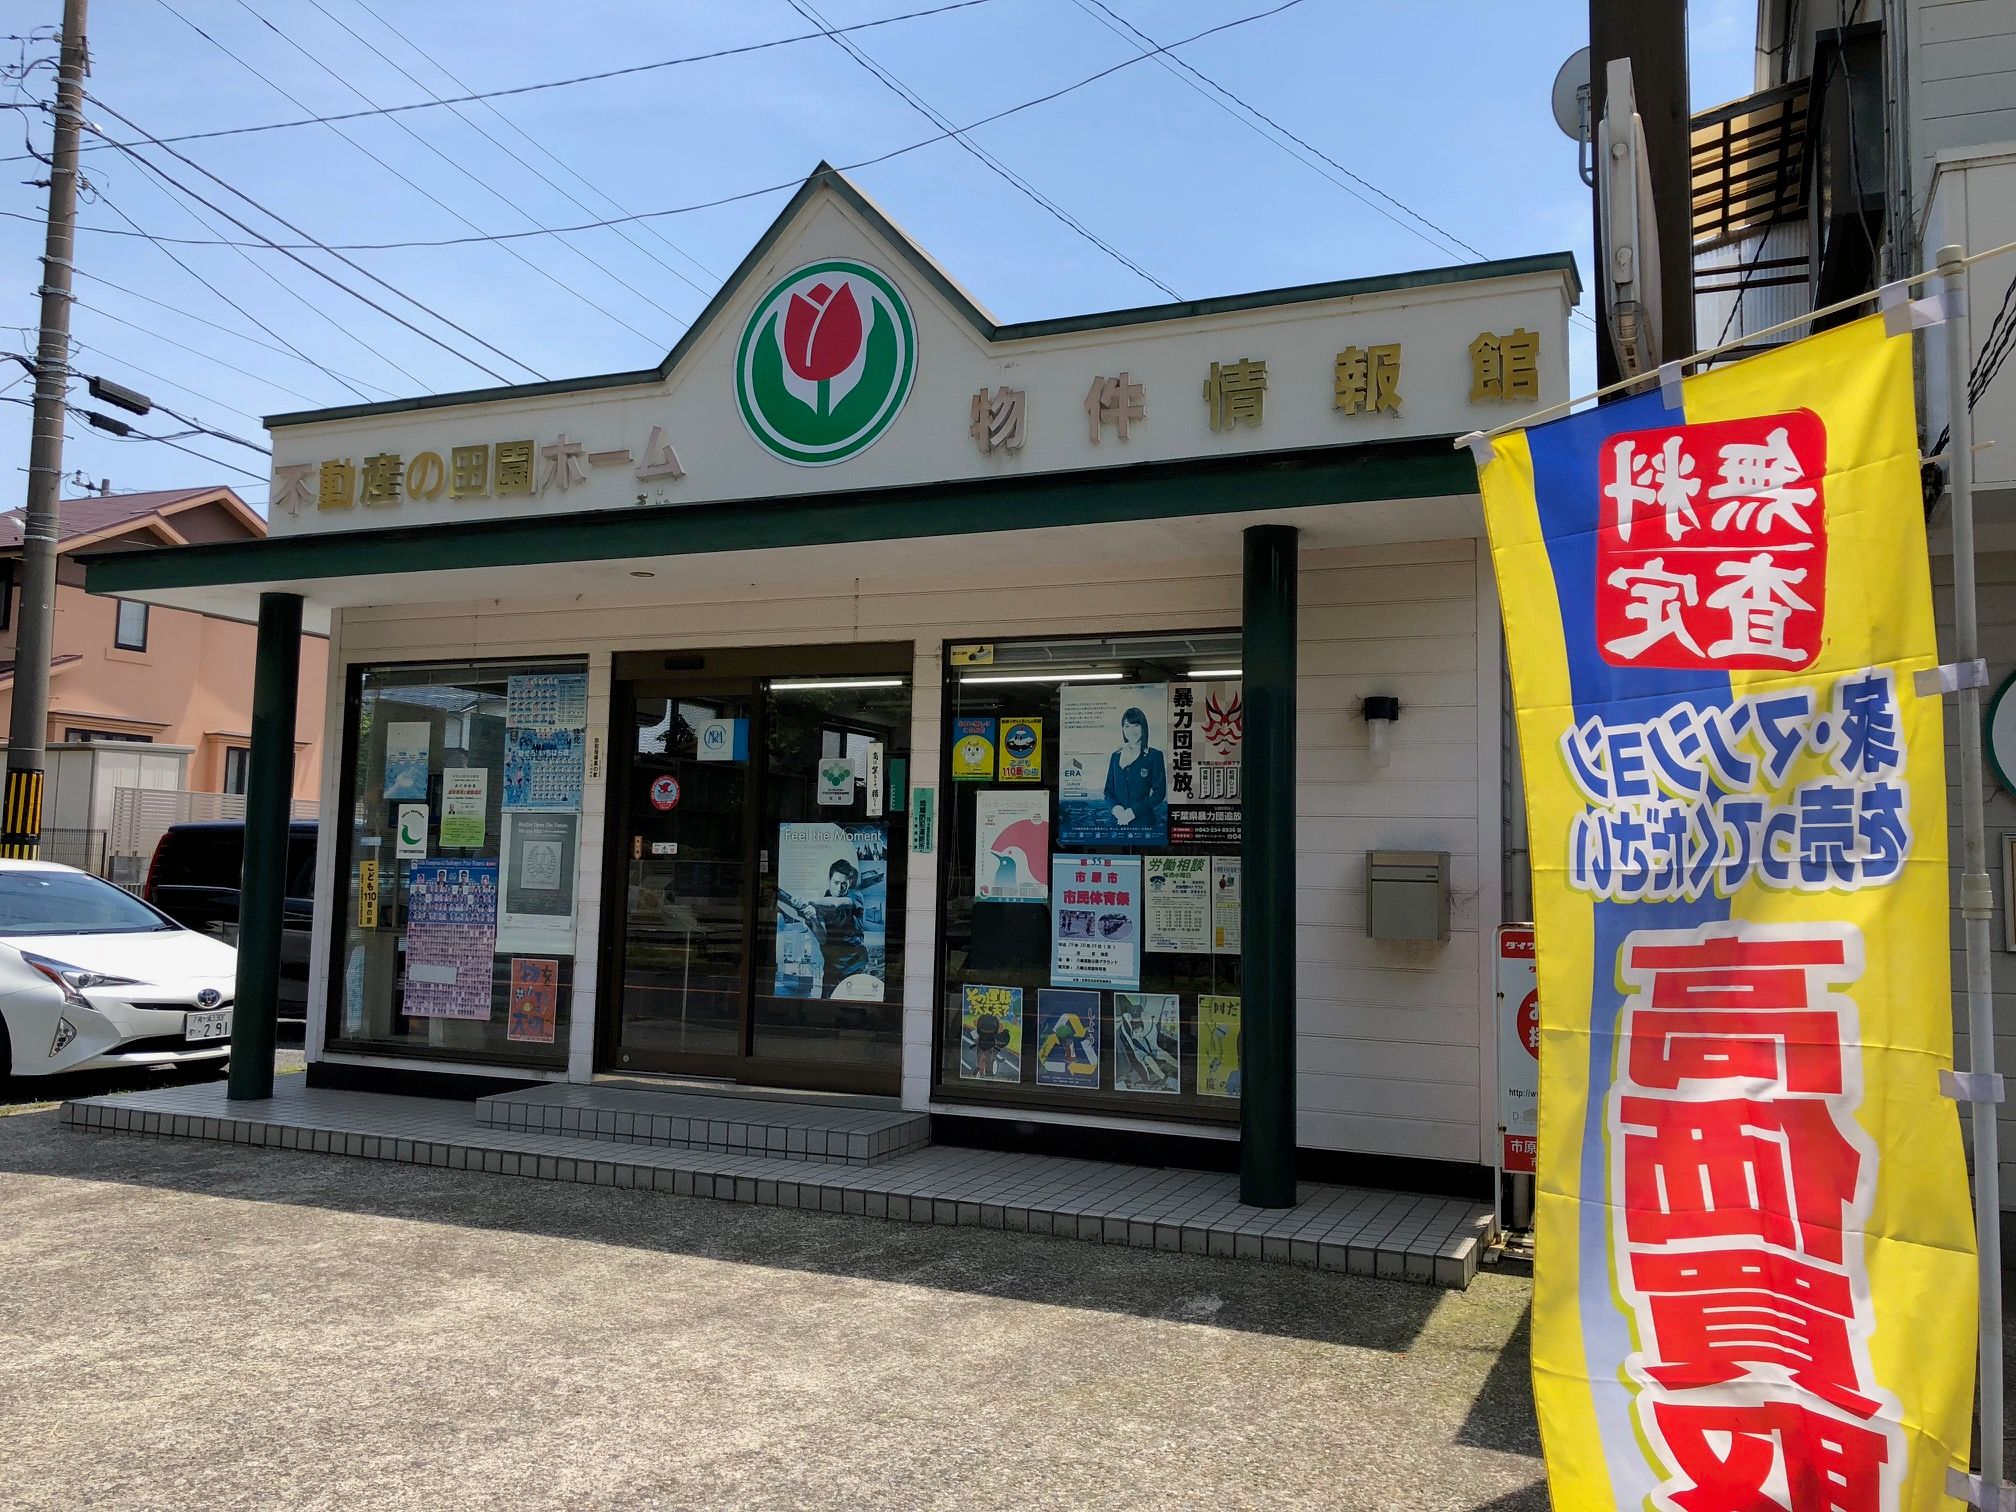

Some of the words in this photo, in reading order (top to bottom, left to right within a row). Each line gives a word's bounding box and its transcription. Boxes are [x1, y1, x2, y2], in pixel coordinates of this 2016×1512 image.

[970, 328, 1541, 454] 物件情報館
[274, 426, 687, 515] 不動産の田園ホーム
[1173, 687, 1194, 799] 暴力団追放。
[785, 829, 810, 841] Feel
[813, 829, 830, 841] the
[834, 829, 882, 842] Moment
[1147, 858, 1206, 872] 労働相談
[1075, 871, 1118, 883] 市原市
[1063, 890, 1130, 906] 市民体育祭
